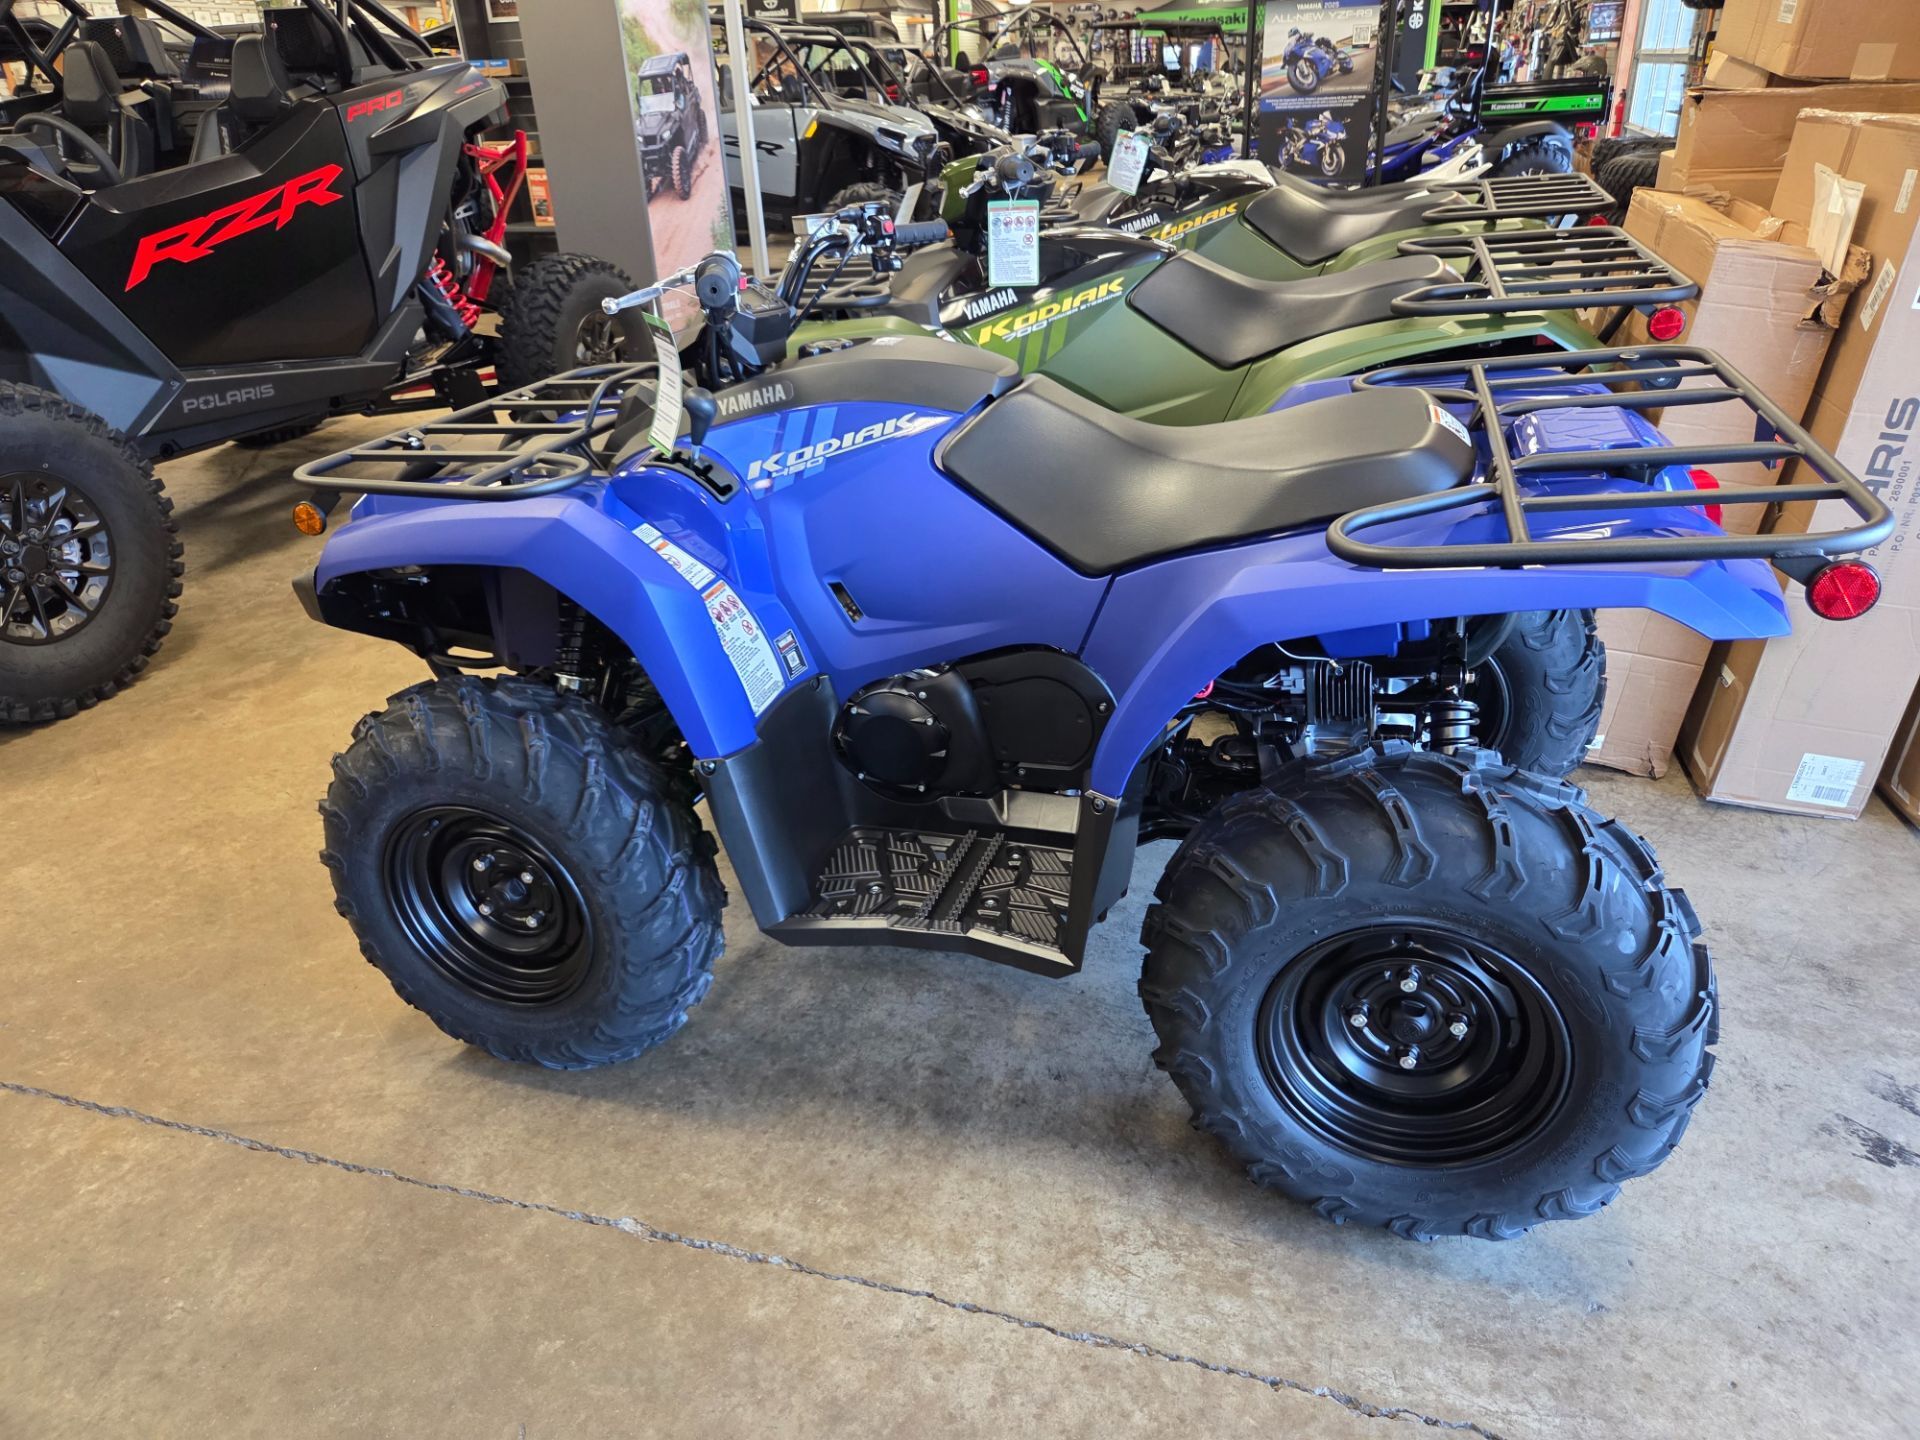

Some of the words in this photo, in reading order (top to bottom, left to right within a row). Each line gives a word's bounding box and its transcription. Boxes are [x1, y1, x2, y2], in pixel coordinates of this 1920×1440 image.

[1272, 12, 1324, 23] ALL-NEW
[346, 89, 403, 122] PRO
[1490, 102, 1526, 111] Kawasaki
[124, 164, 343, 291] RZR
[963, 287, 1018, 321] YAMAHA
[978, 276, 1125, 345] KODIAK
[1001, 318, 1047, 342] 700
[182, 383, 275, 414] POLARIS
[717, 383, 786, 416] YAMAHA
[747, 411, 917, 480] KODIAK
[772, 456, 824, 478] 450
[1889, 460, 1912, 501] 2890001
